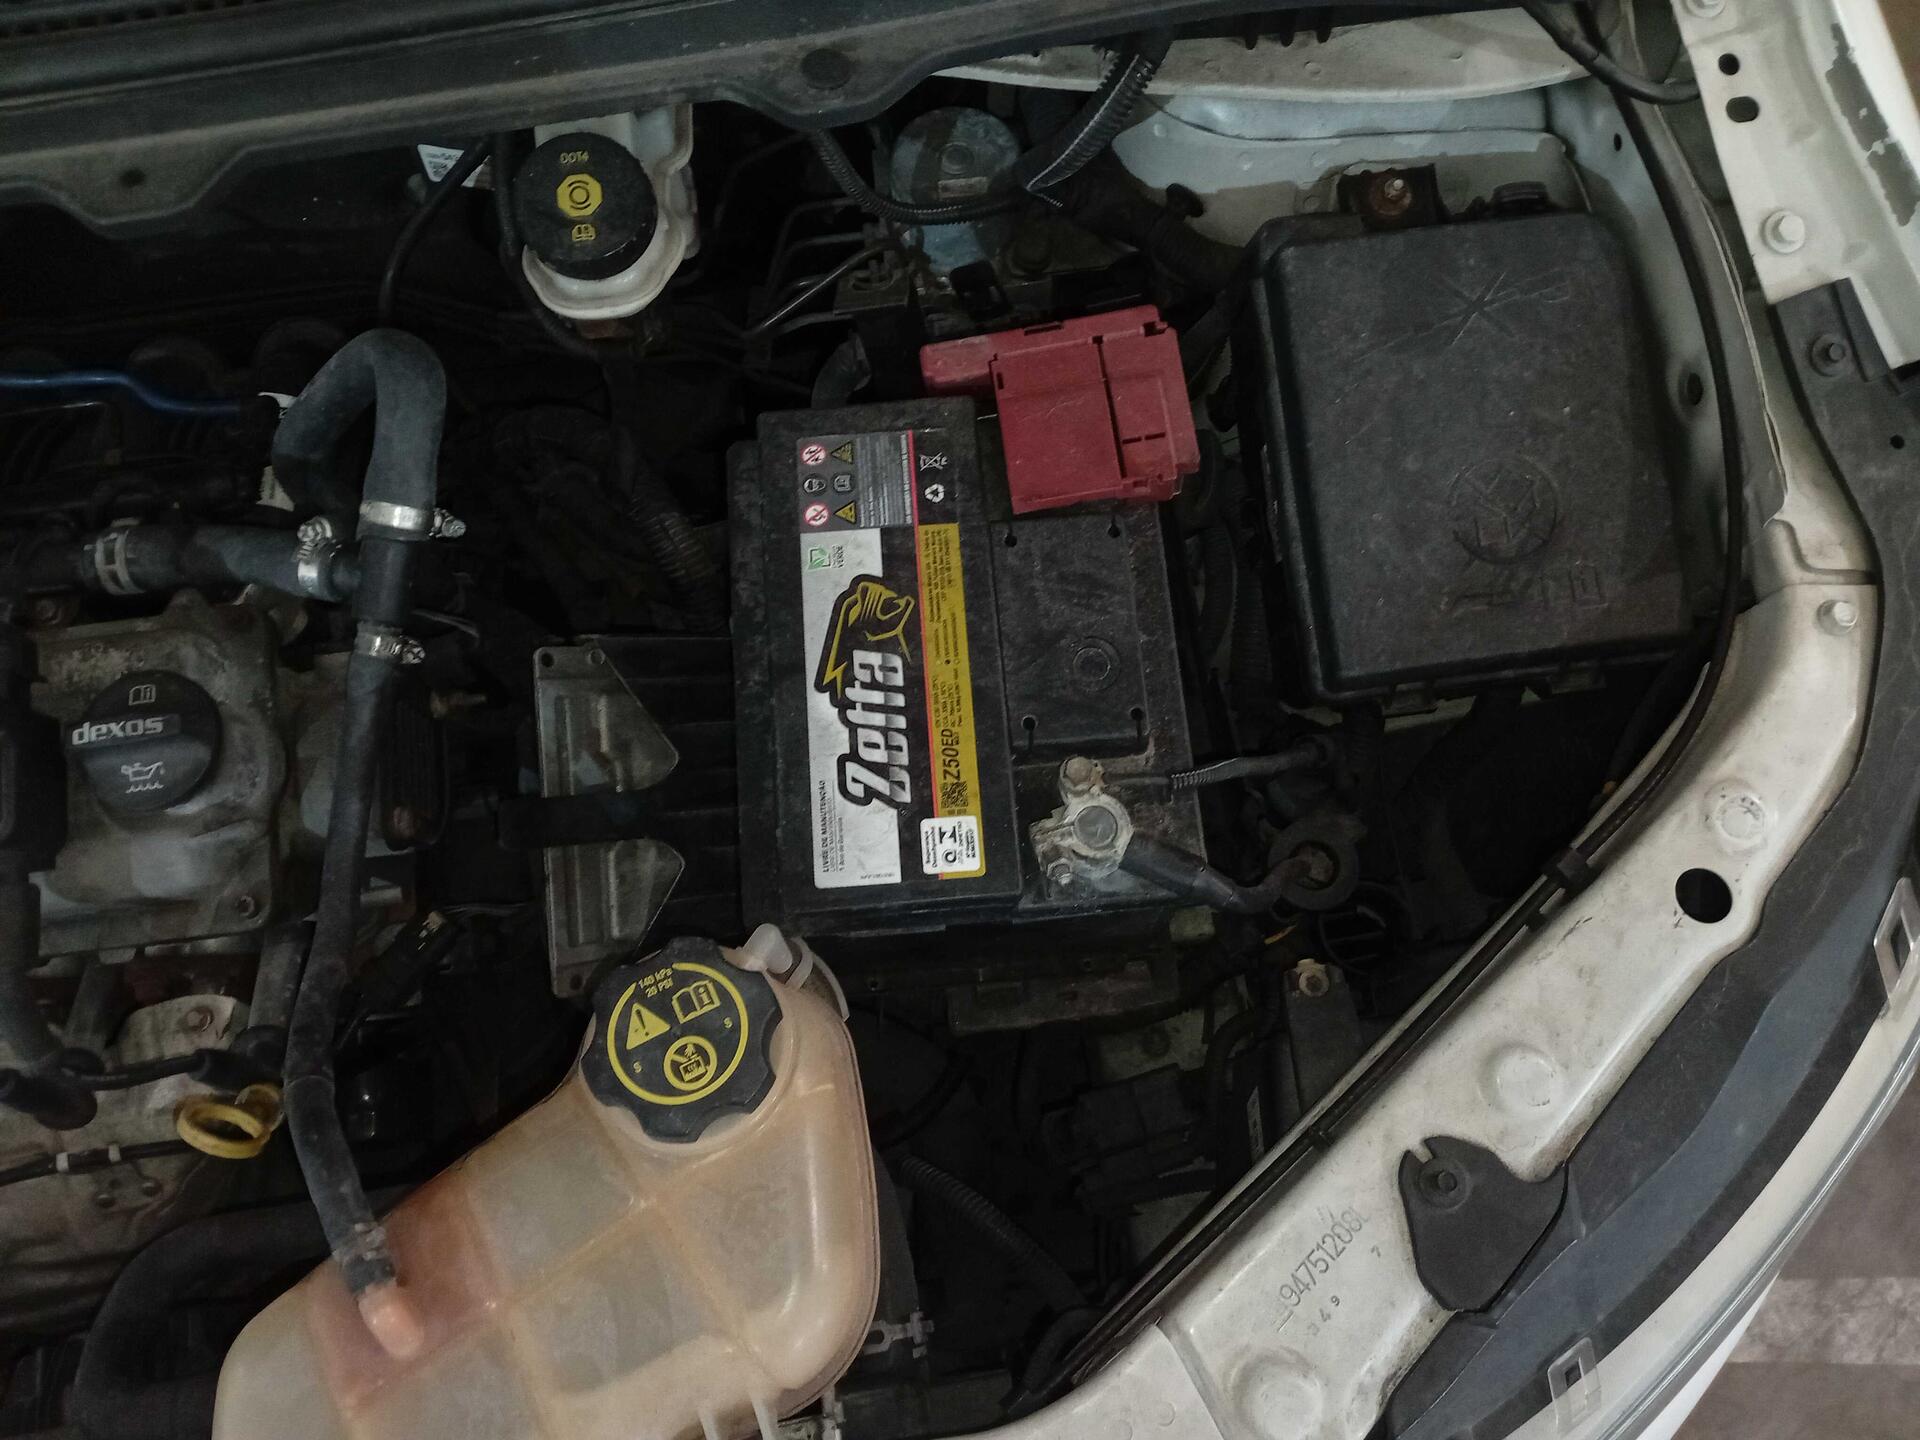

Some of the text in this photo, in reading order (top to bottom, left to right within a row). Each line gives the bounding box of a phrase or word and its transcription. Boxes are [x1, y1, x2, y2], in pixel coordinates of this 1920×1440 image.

[71, 716, 164, 746] dexos
[844, 649, 912, 804] Zetta
[941, 728, 961, 781] Z50ED
